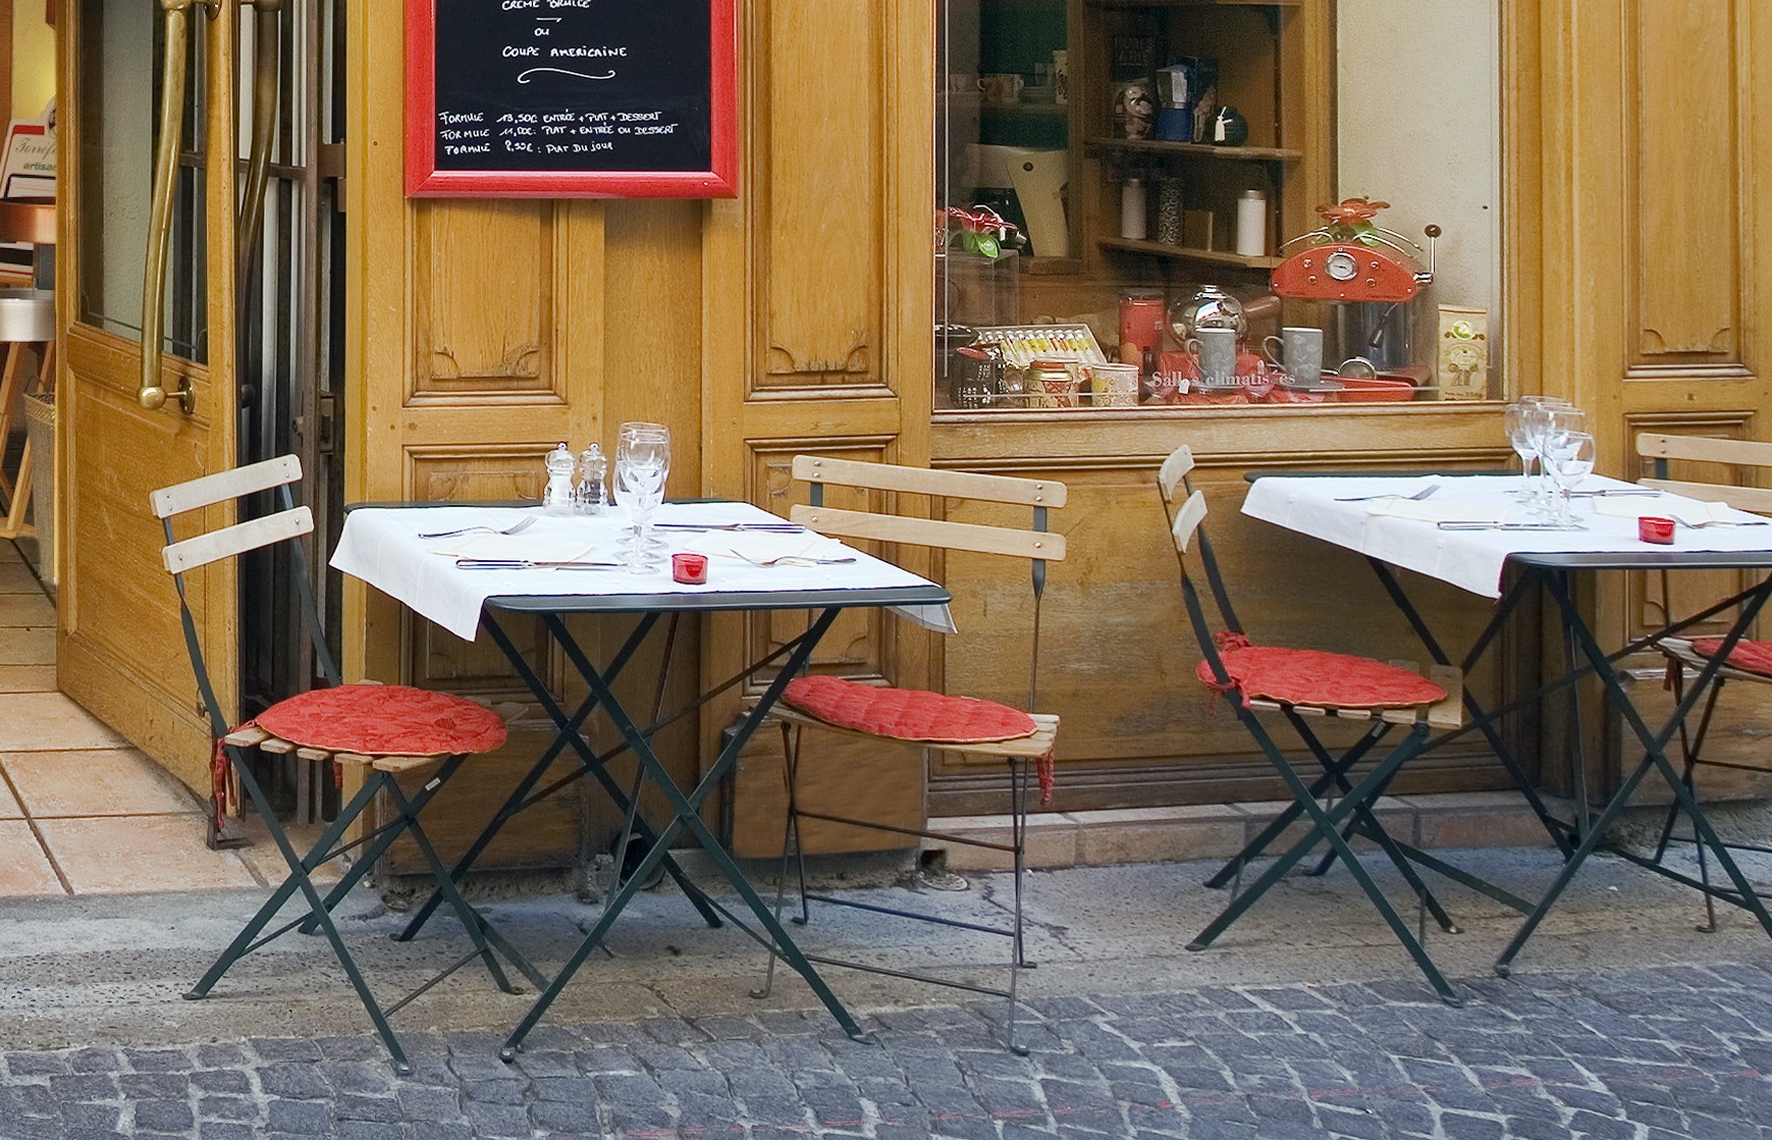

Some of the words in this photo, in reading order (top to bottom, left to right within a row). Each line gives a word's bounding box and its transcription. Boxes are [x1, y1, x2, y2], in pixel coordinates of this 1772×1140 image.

[502, 46, 540, 57] COUPE
[438, 111, 484, 125] FORMULE
[440, 129, 490, 140] FORMULE
[541, 125, 567, 135] PLAT
[634, 123, 679, 135] DESSERT
[444, 142, 490, 155] FORMULE
[546, 144, 569, 154] PLAT
[1151, 370, 1199, 388] Salls
[1205, 371, 1296, 387] climatises
